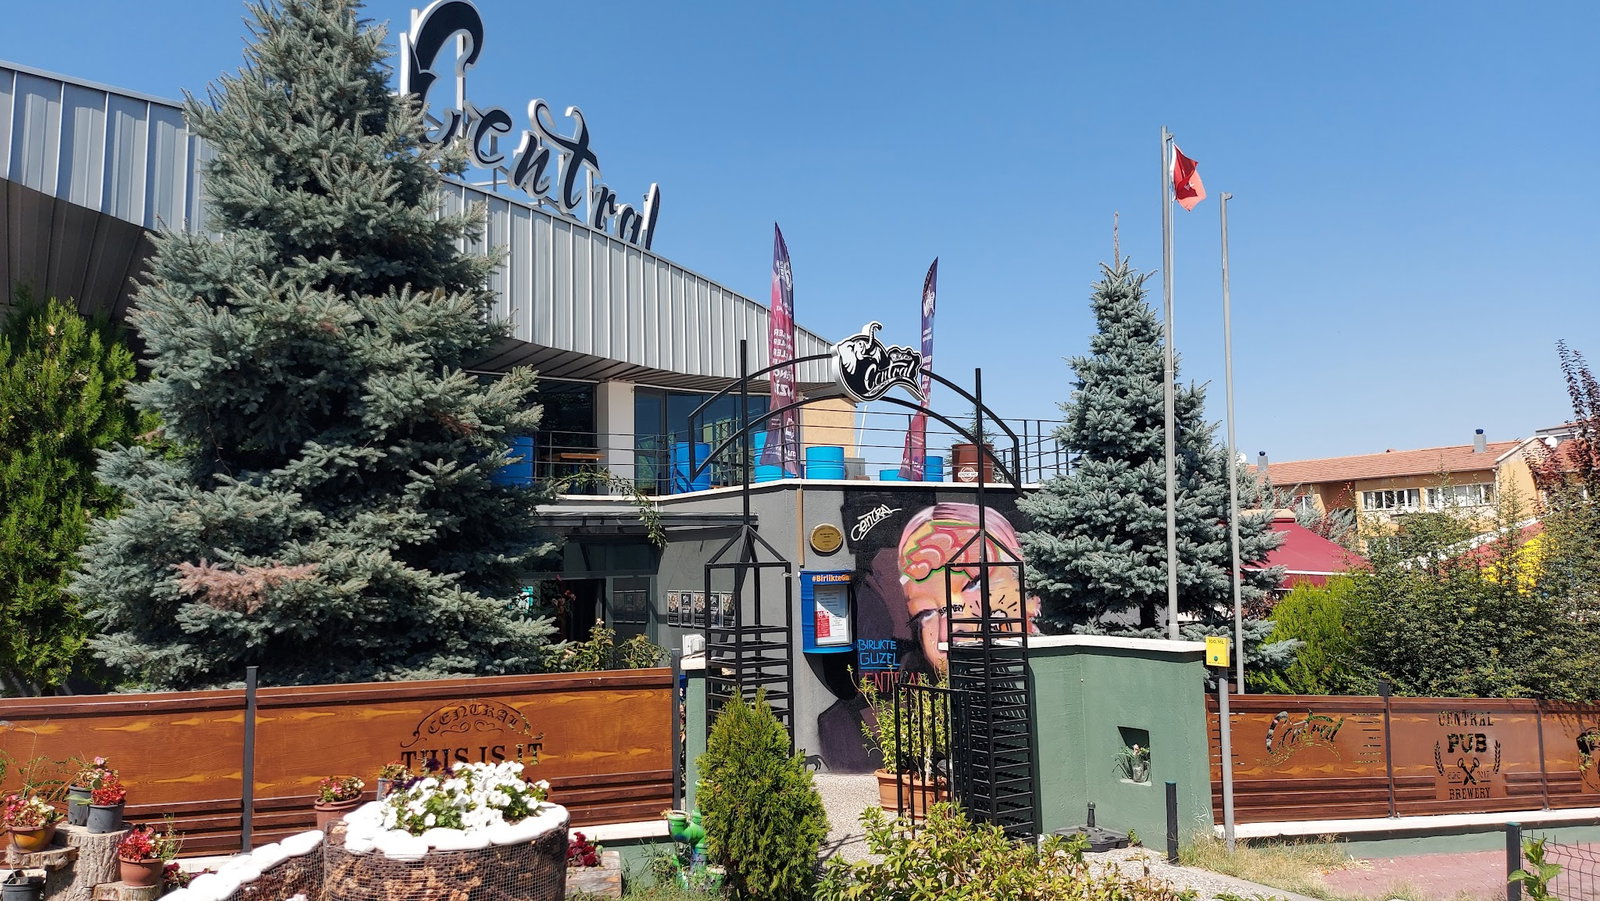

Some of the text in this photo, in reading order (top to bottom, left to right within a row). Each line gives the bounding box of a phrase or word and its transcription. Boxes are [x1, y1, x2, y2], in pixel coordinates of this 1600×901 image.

[399, 0, 660, 250] Central
[864, 360, 915, 391] Central
[428, 704, 519, 734] CENTRAL
[1266, 708, 1344, 755] Central
[1438, 710, 1494, 726] CENTRAL
[401, 743, 543, 772] THIS IS IT
[1447, 733, 1487, 753] PUB
[1449, 787, 1491, 800] BREWERY
